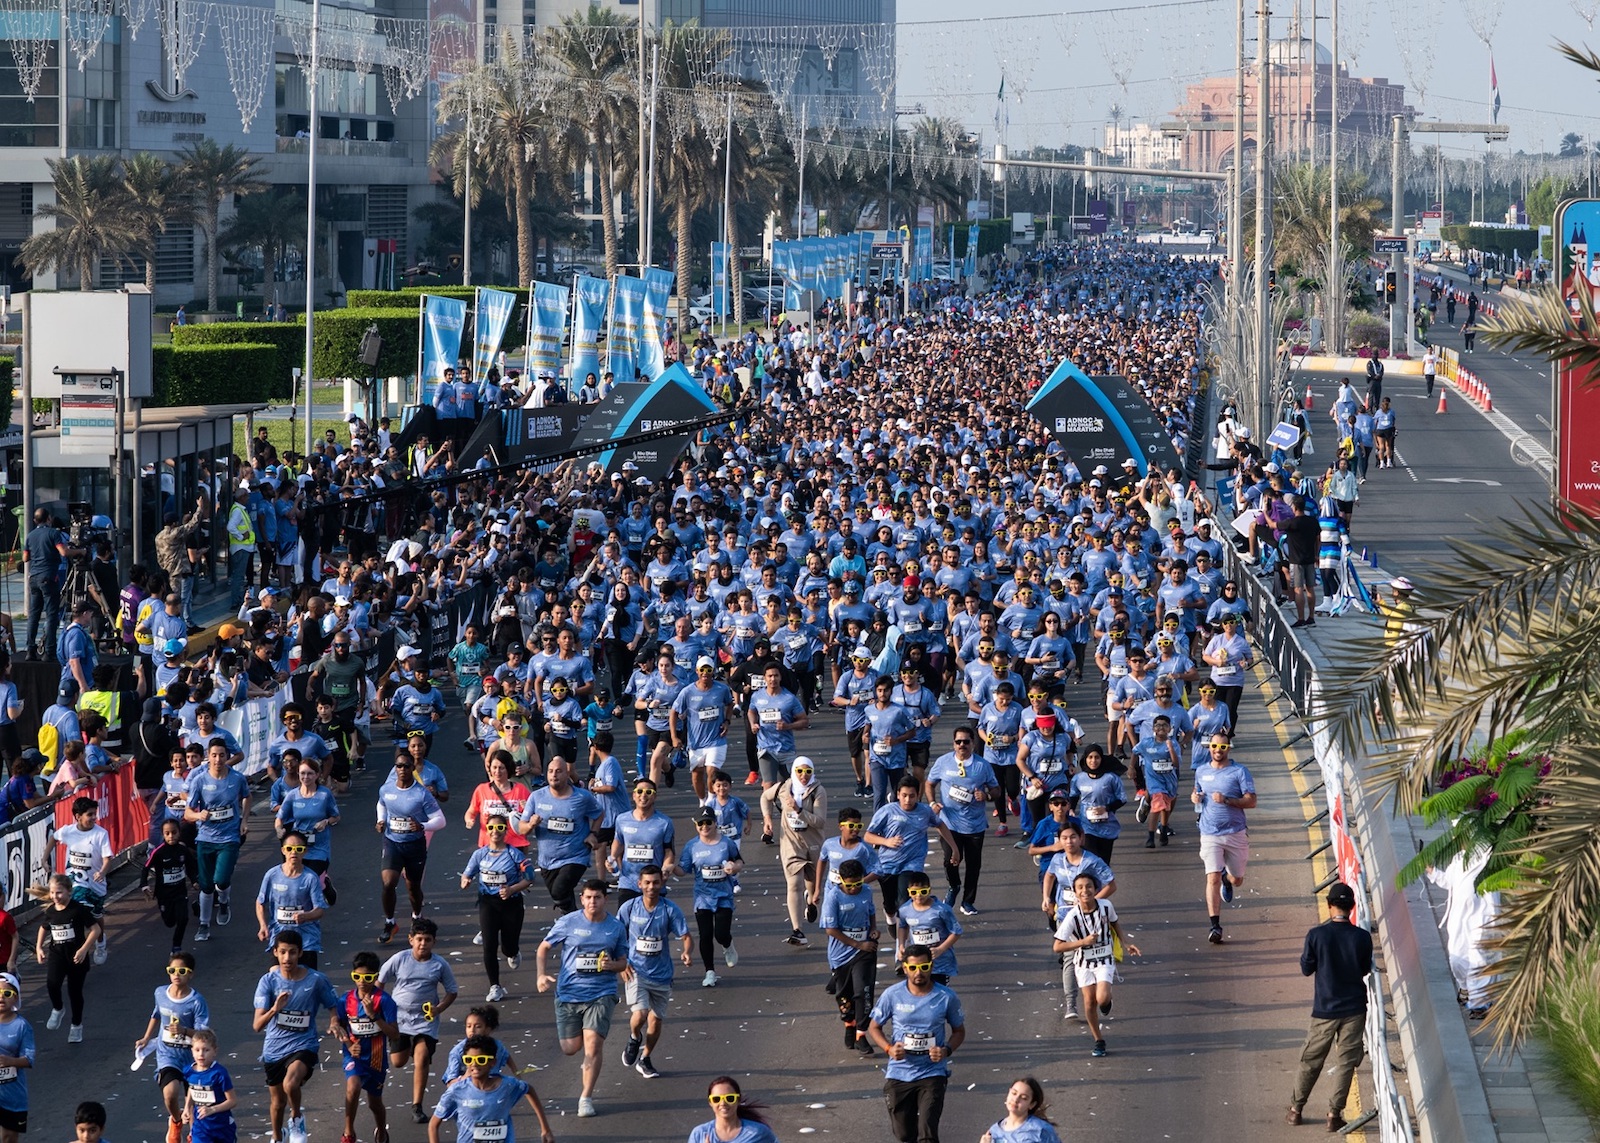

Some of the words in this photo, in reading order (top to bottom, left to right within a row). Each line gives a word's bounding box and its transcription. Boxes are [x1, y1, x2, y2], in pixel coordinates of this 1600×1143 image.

[537, 416, 555, 424] ADNOC
[537, 430, 562, 438] MARATHON
[482, 1128, 502, 1136] 25414
